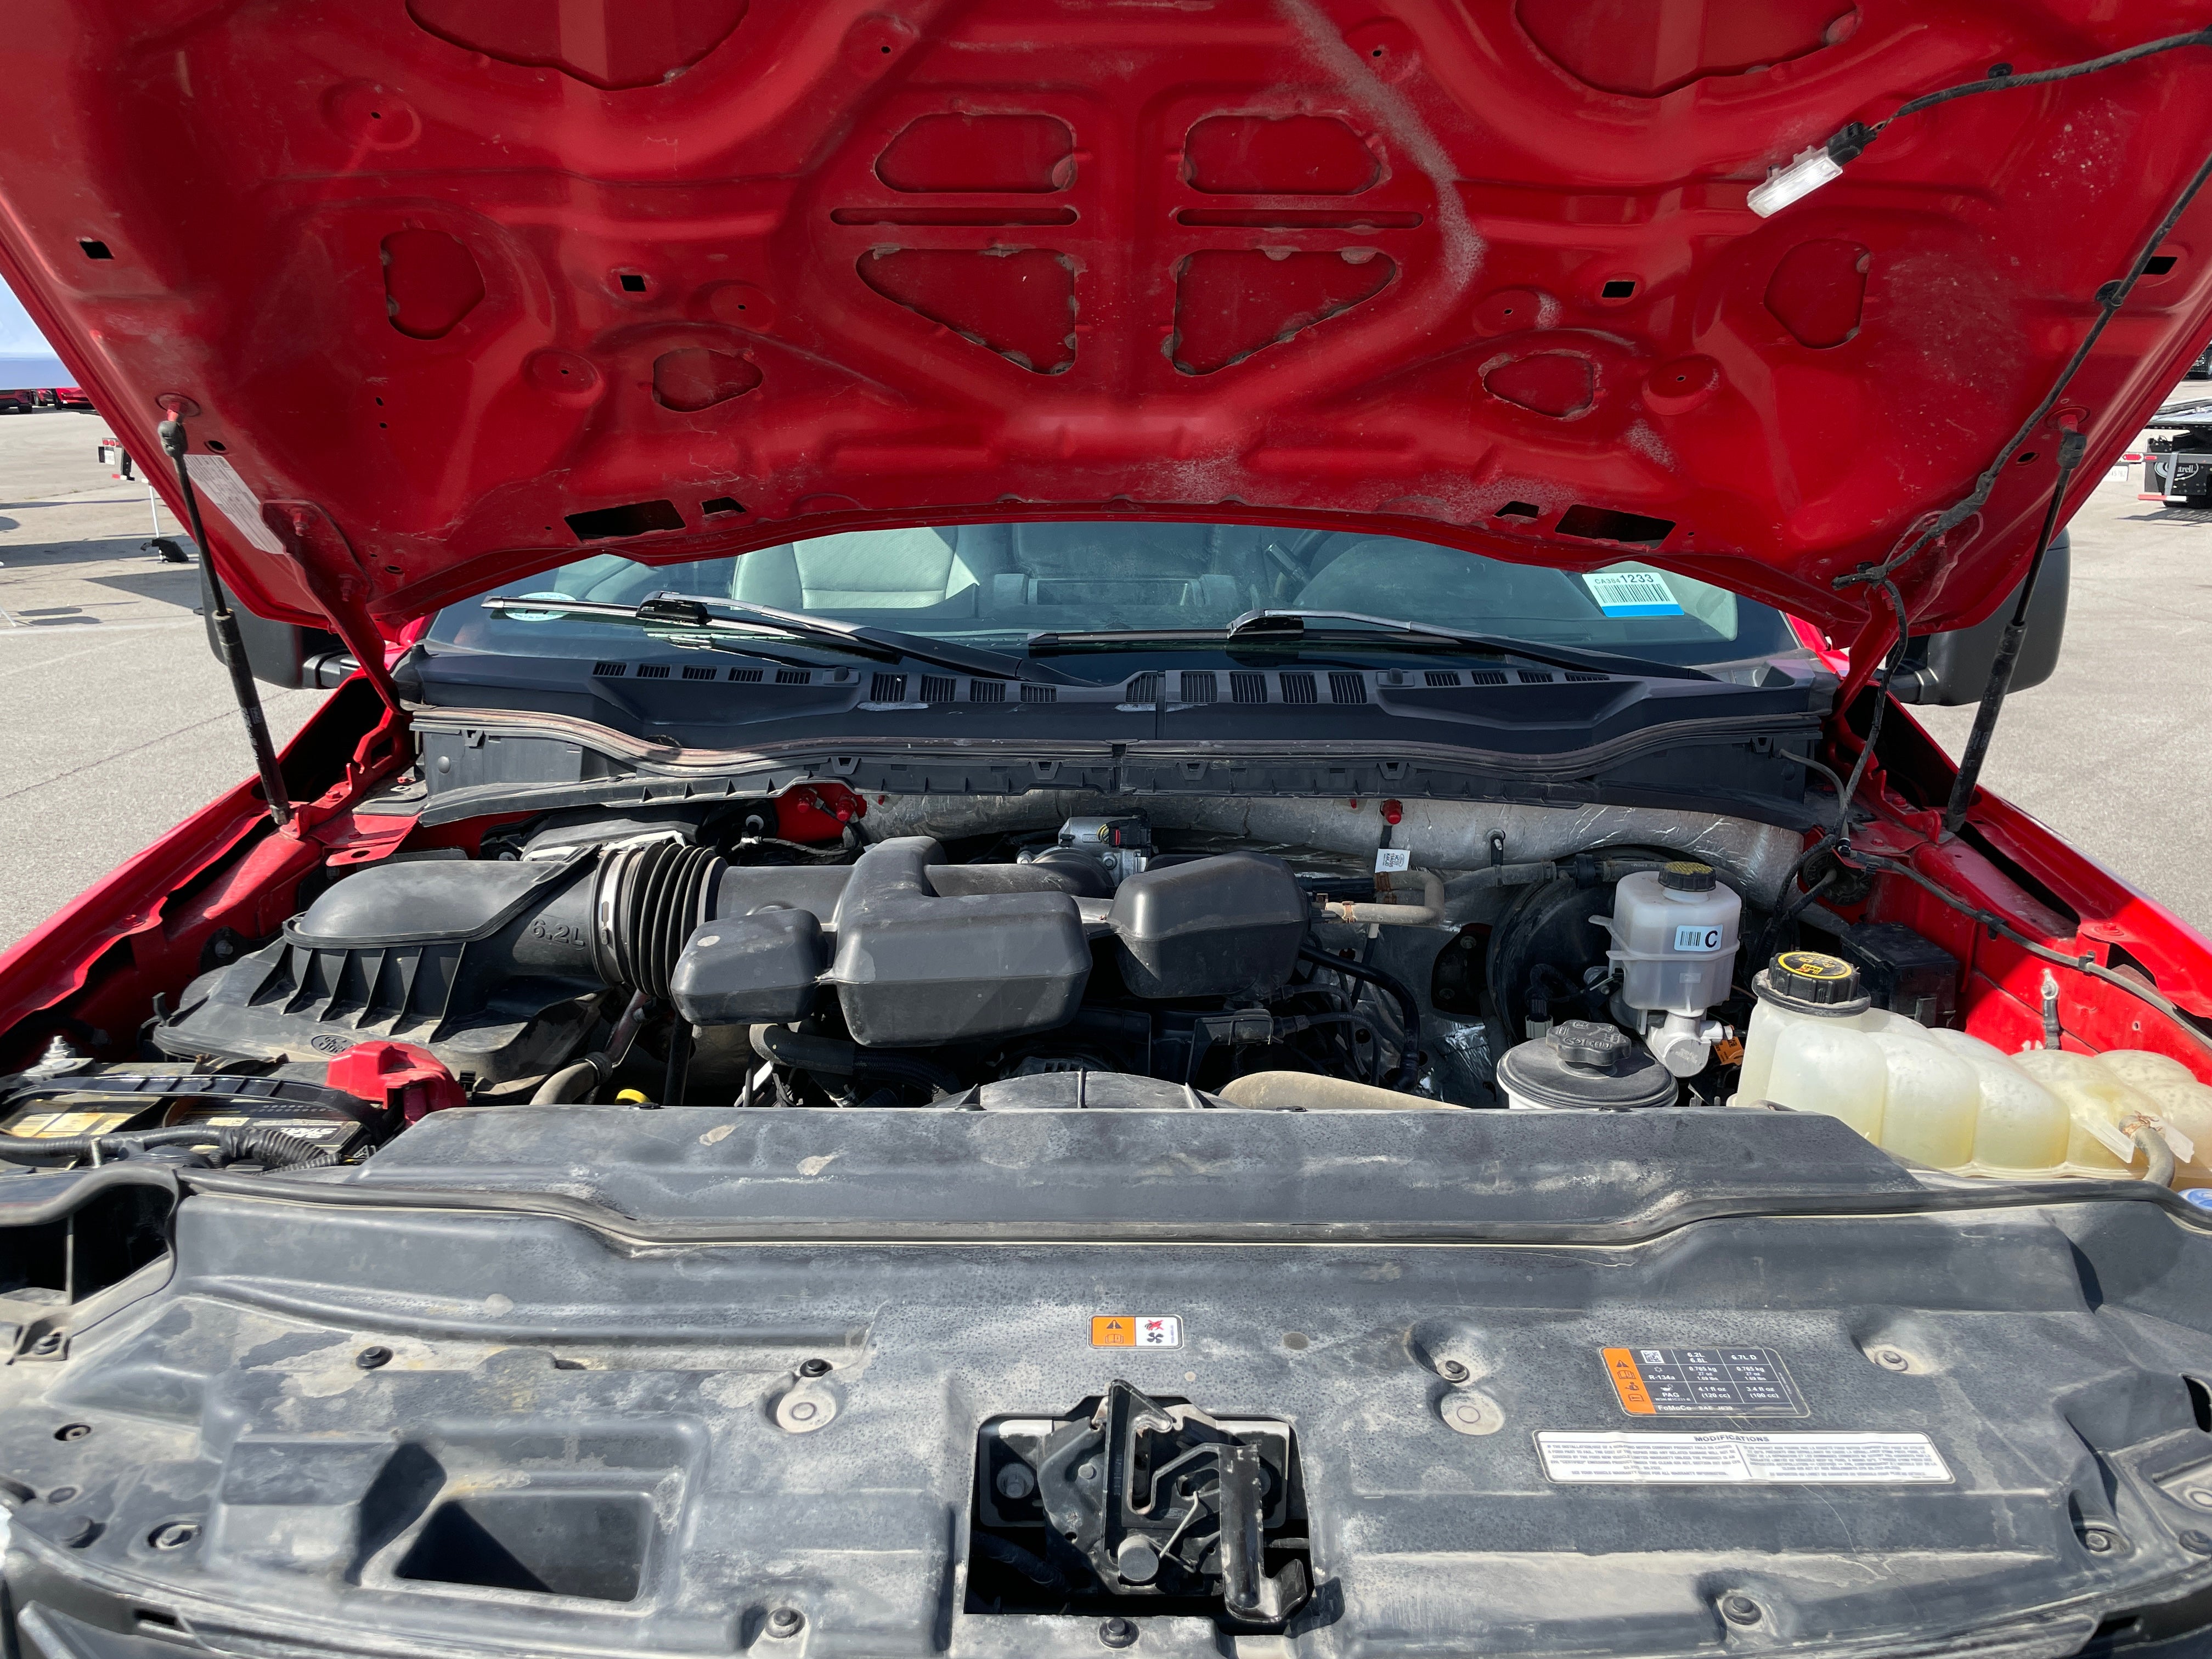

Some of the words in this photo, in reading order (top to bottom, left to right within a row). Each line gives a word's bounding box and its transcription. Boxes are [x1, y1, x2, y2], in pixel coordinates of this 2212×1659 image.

[530, 918, 585, 948] 6.2L
[1705, 930, 1718, 948] C
[1694, 1434, 1770, 1442] MODIFICATIONS
